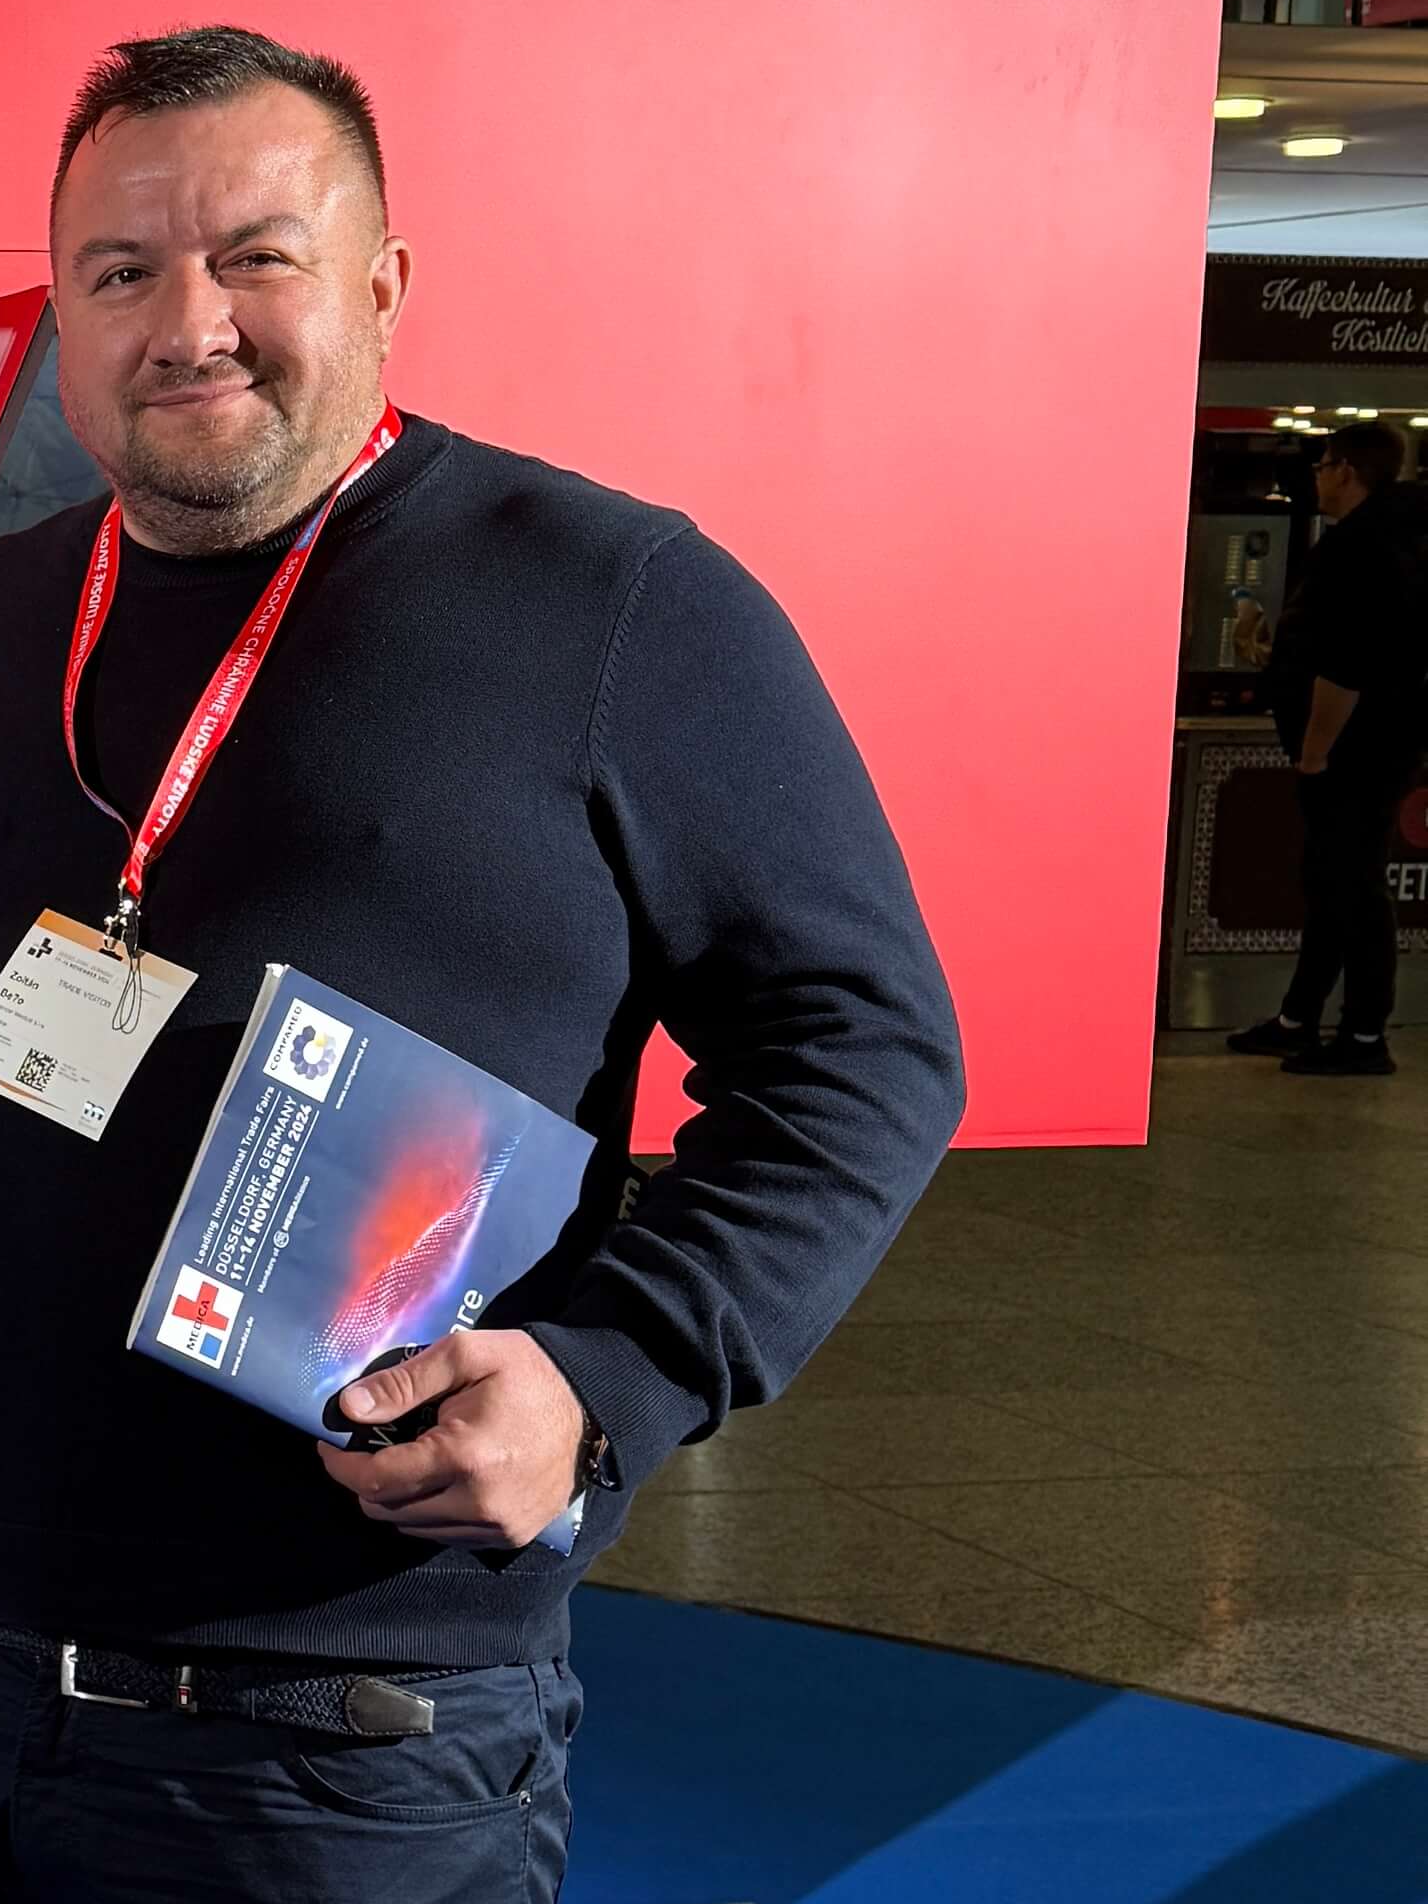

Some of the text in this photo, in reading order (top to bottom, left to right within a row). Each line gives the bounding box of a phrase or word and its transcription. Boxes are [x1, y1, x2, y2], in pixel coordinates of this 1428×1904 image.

[1261, 277, 1415, 320] Kaffeekultur
[268, 1004, 303, 1071] COMPAMED
[257, 1094, 299, 1170] GERMANY
[192, 1084, 275, 1264] Leading International Trade Fairs
[247, 1142, 296, 1234] NOVEMBER
[287, 1102, 313, 1141] 2024
[185, 1297, 211, 1350] MEDICA
